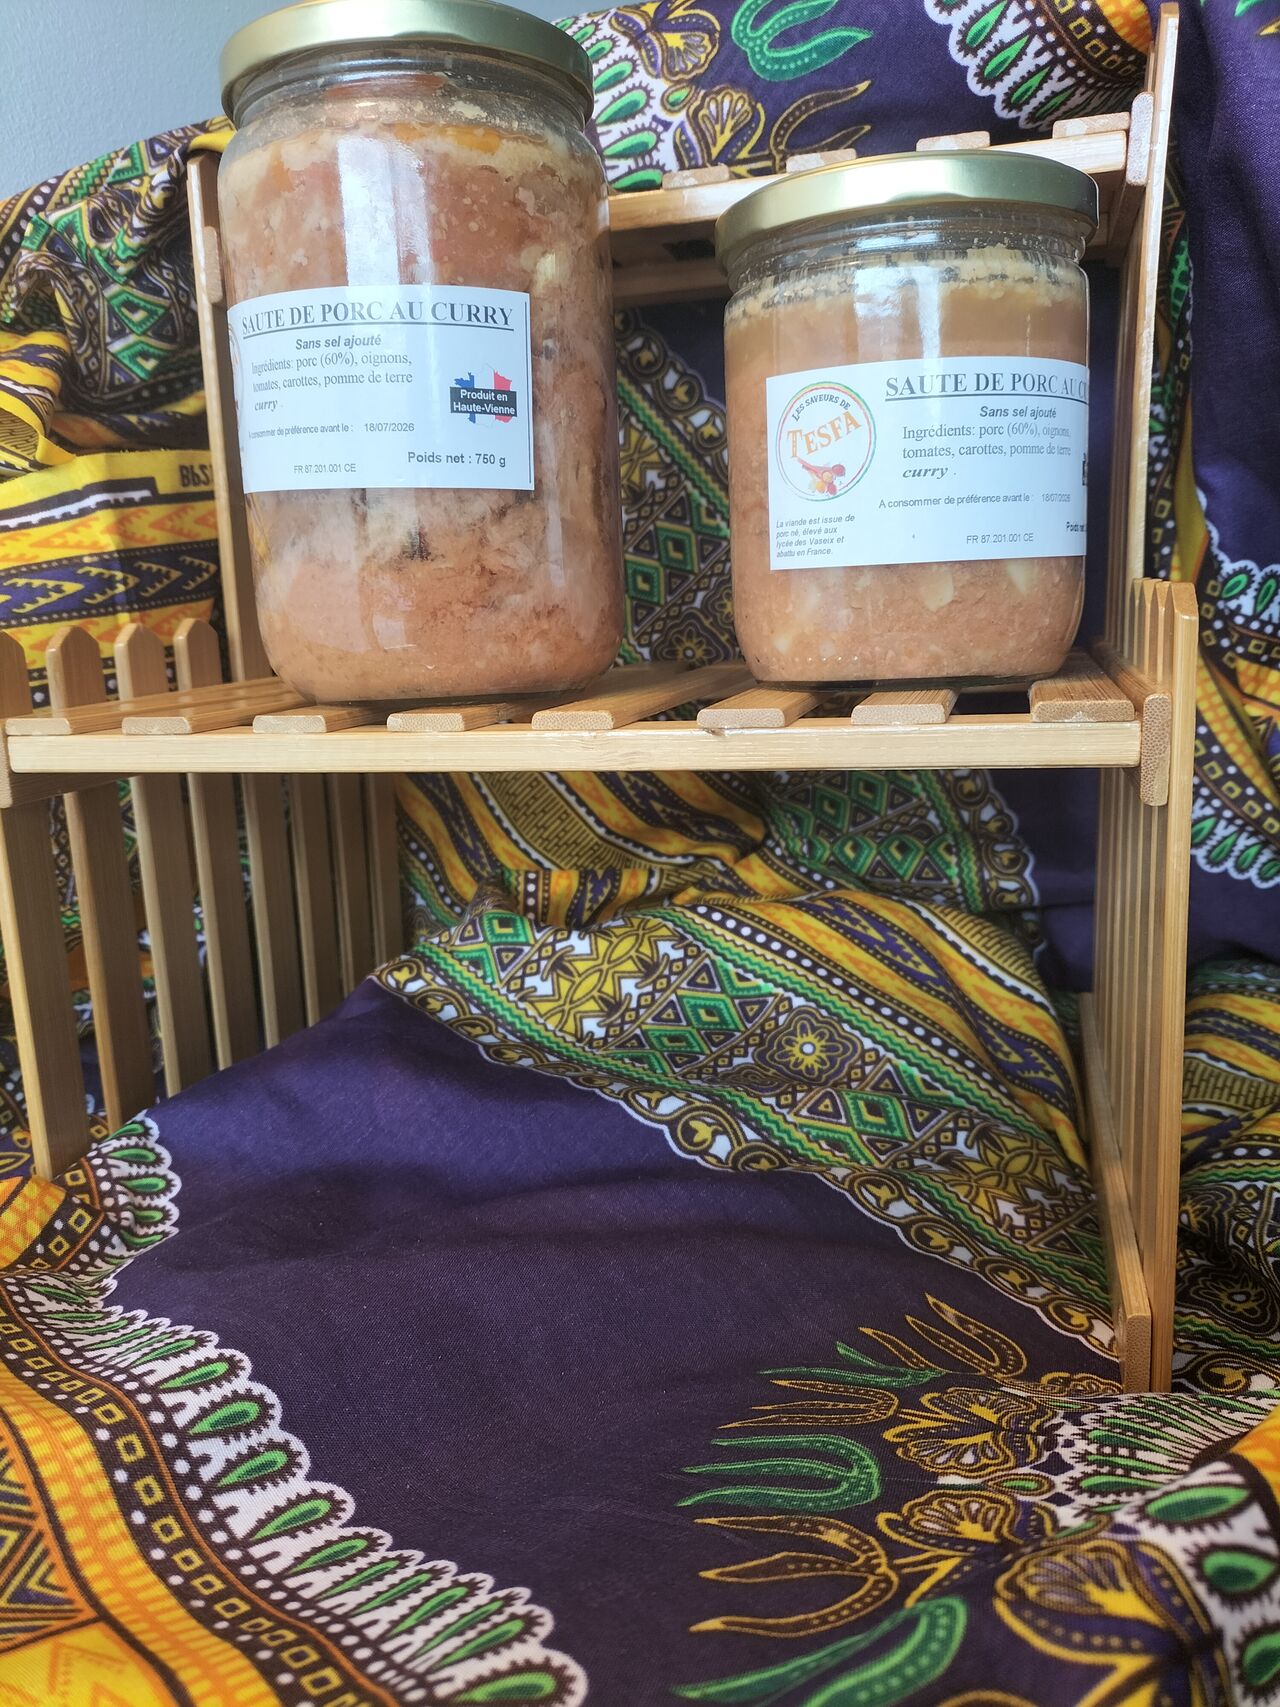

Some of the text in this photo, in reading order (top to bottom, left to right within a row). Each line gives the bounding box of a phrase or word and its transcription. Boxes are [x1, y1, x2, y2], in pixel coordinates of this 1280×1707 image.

[242, 301, 513, 335] SAUTE DE PORC AU CURRY
[295, 334, 382, 350] Sans sel ajouté
[296, 357, 318, 371] porc
[320, 351, 358, 368] (60%),
[361, 350, 412, 367] oignons,
[282, 376, 322, 389] carottes,
[324, 374, 365, 388] pomme
[368, 370, 382, 384] de
[385, 372, 413, 383] terre
[886, 373, 967, 397] SAUTE
[974, 372, 1004, 392] DE
[1010, 373, 1058, 394] PORC
[1061, 378, 1077, 396] AU
[460, 389, 508, 402] Produit en
[254, 400, 278, 412] curry
[453, 401, 516, 415] Haute-Vienne
[791, 394, 851, 422] LES SAVEURS DE
[979, 405, 1057, 420] Sans sel ajouté
[284, 424, 319, 437] préférence
[320, 424, 340, 433] avant
[341, 423, 349, 432] le
[364, 422, 415, 432] 18/07/2026
[787, 411, 862, 459] TESFA
[902, 423, 975, 442] Ingrédients:
[979, 425, 1004, 439] porc
[902, 446, 956, 459] tomates,
[958, 443, 1007, 457] carottes,
[1010, 444, 1044, 457] pomme
[1046, 442, 1056, 455] de
[408, 452, 442, 463] Poids
[446, 453, 465, 464] net
[475, 453, 496, 465] 750
[499, 456, 506, 468] g
[293, 465, 303, 474] FR
[344, 463, 357, 473] CE
[902, 467, 949, 480] curry
[878, 499, 886, 509] A
[887, 498, 942, 508] consommer
[944, 496, 956, 505] de
[956, 494, 1001, 506] préférence
[1002, 494, 1022, 503] avant
[1023, 492, 1030, 502] le
[776, 514, 856, 528] La viande est issue de
[776, 531, 789, 540] porc
[802, 527, 822, 536] élevé
[966, 532, 1034, 544] FR 87.201.001 CE
[776, 540, 794, 550] lycée
[794, 539, 807, 547] des
[836, 536, 845, 544] et
